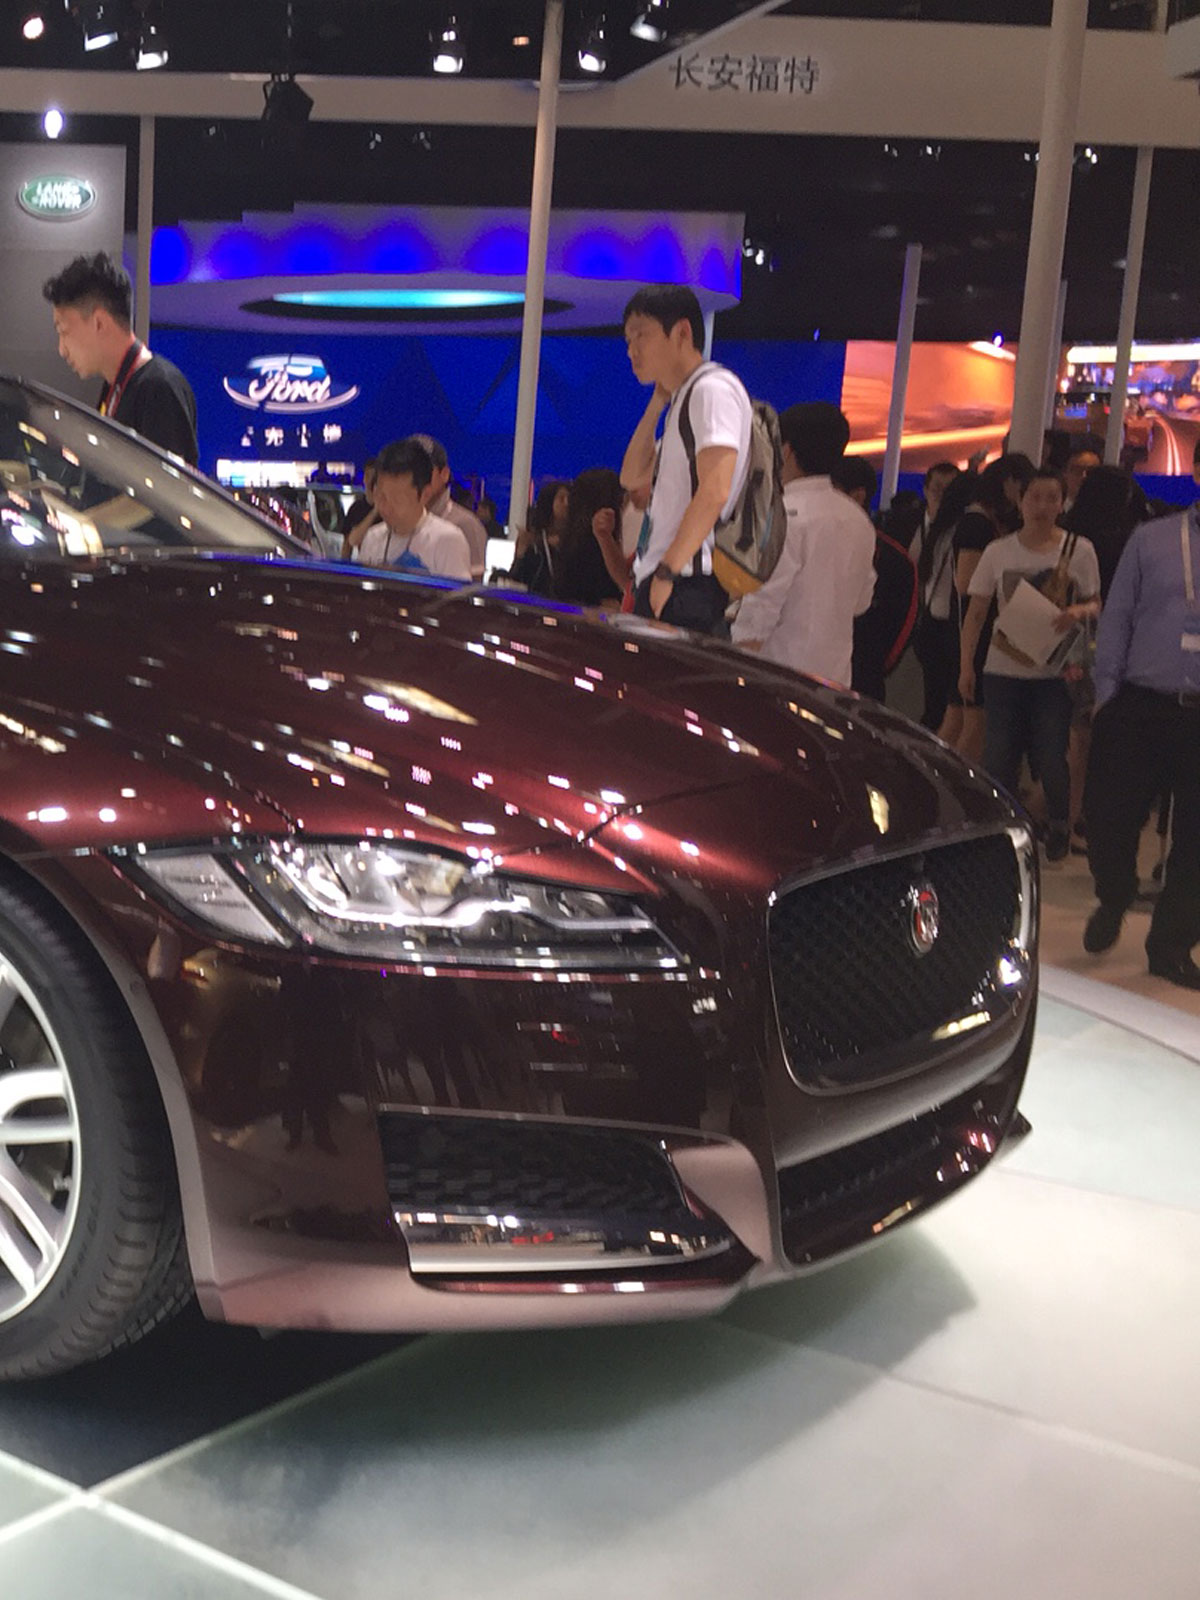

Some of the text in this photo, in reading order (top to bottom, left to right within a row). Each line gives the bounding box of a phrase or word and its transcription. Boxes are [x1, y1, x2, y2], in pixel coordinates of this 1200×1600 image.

[669, 53, 820, 95] 长安福特
[39, 193, 82, 209] ROVER
[248, 364, 332, 403] Ford
